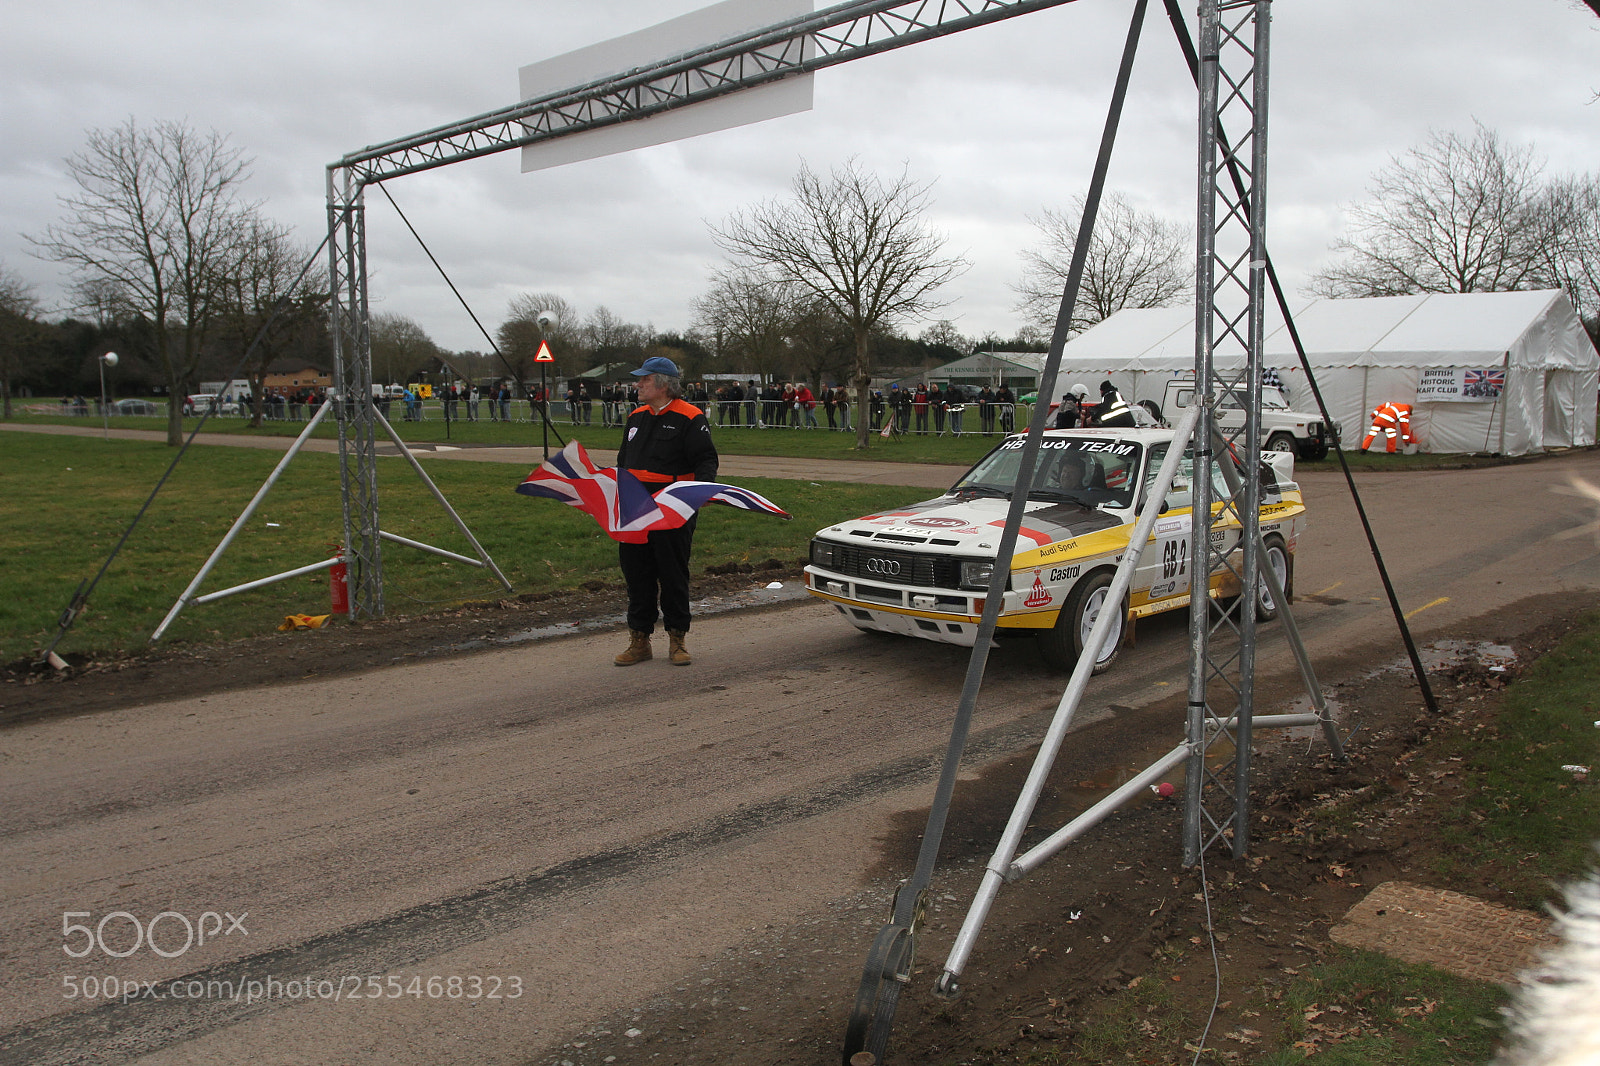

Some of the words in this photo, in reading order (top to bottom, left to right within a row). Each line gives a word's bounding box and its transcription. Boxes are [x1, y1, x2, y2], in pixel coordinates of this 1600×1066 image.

[1420, 378, 1455, 386] HISTORIC
[1000, 440, 1026, 450] HB
[1079, 441, 1135, 456] TEAM
[1040, 546, 1057, 557] Audi
[1057, 541, 1078, 552] Sport
[1163, 540, 1177, 579] GB
[1179, 539, 1186, 575] 2
[1050, 565, 1081, 581] Castrol
[1031, 585, 1047, 600] HB
